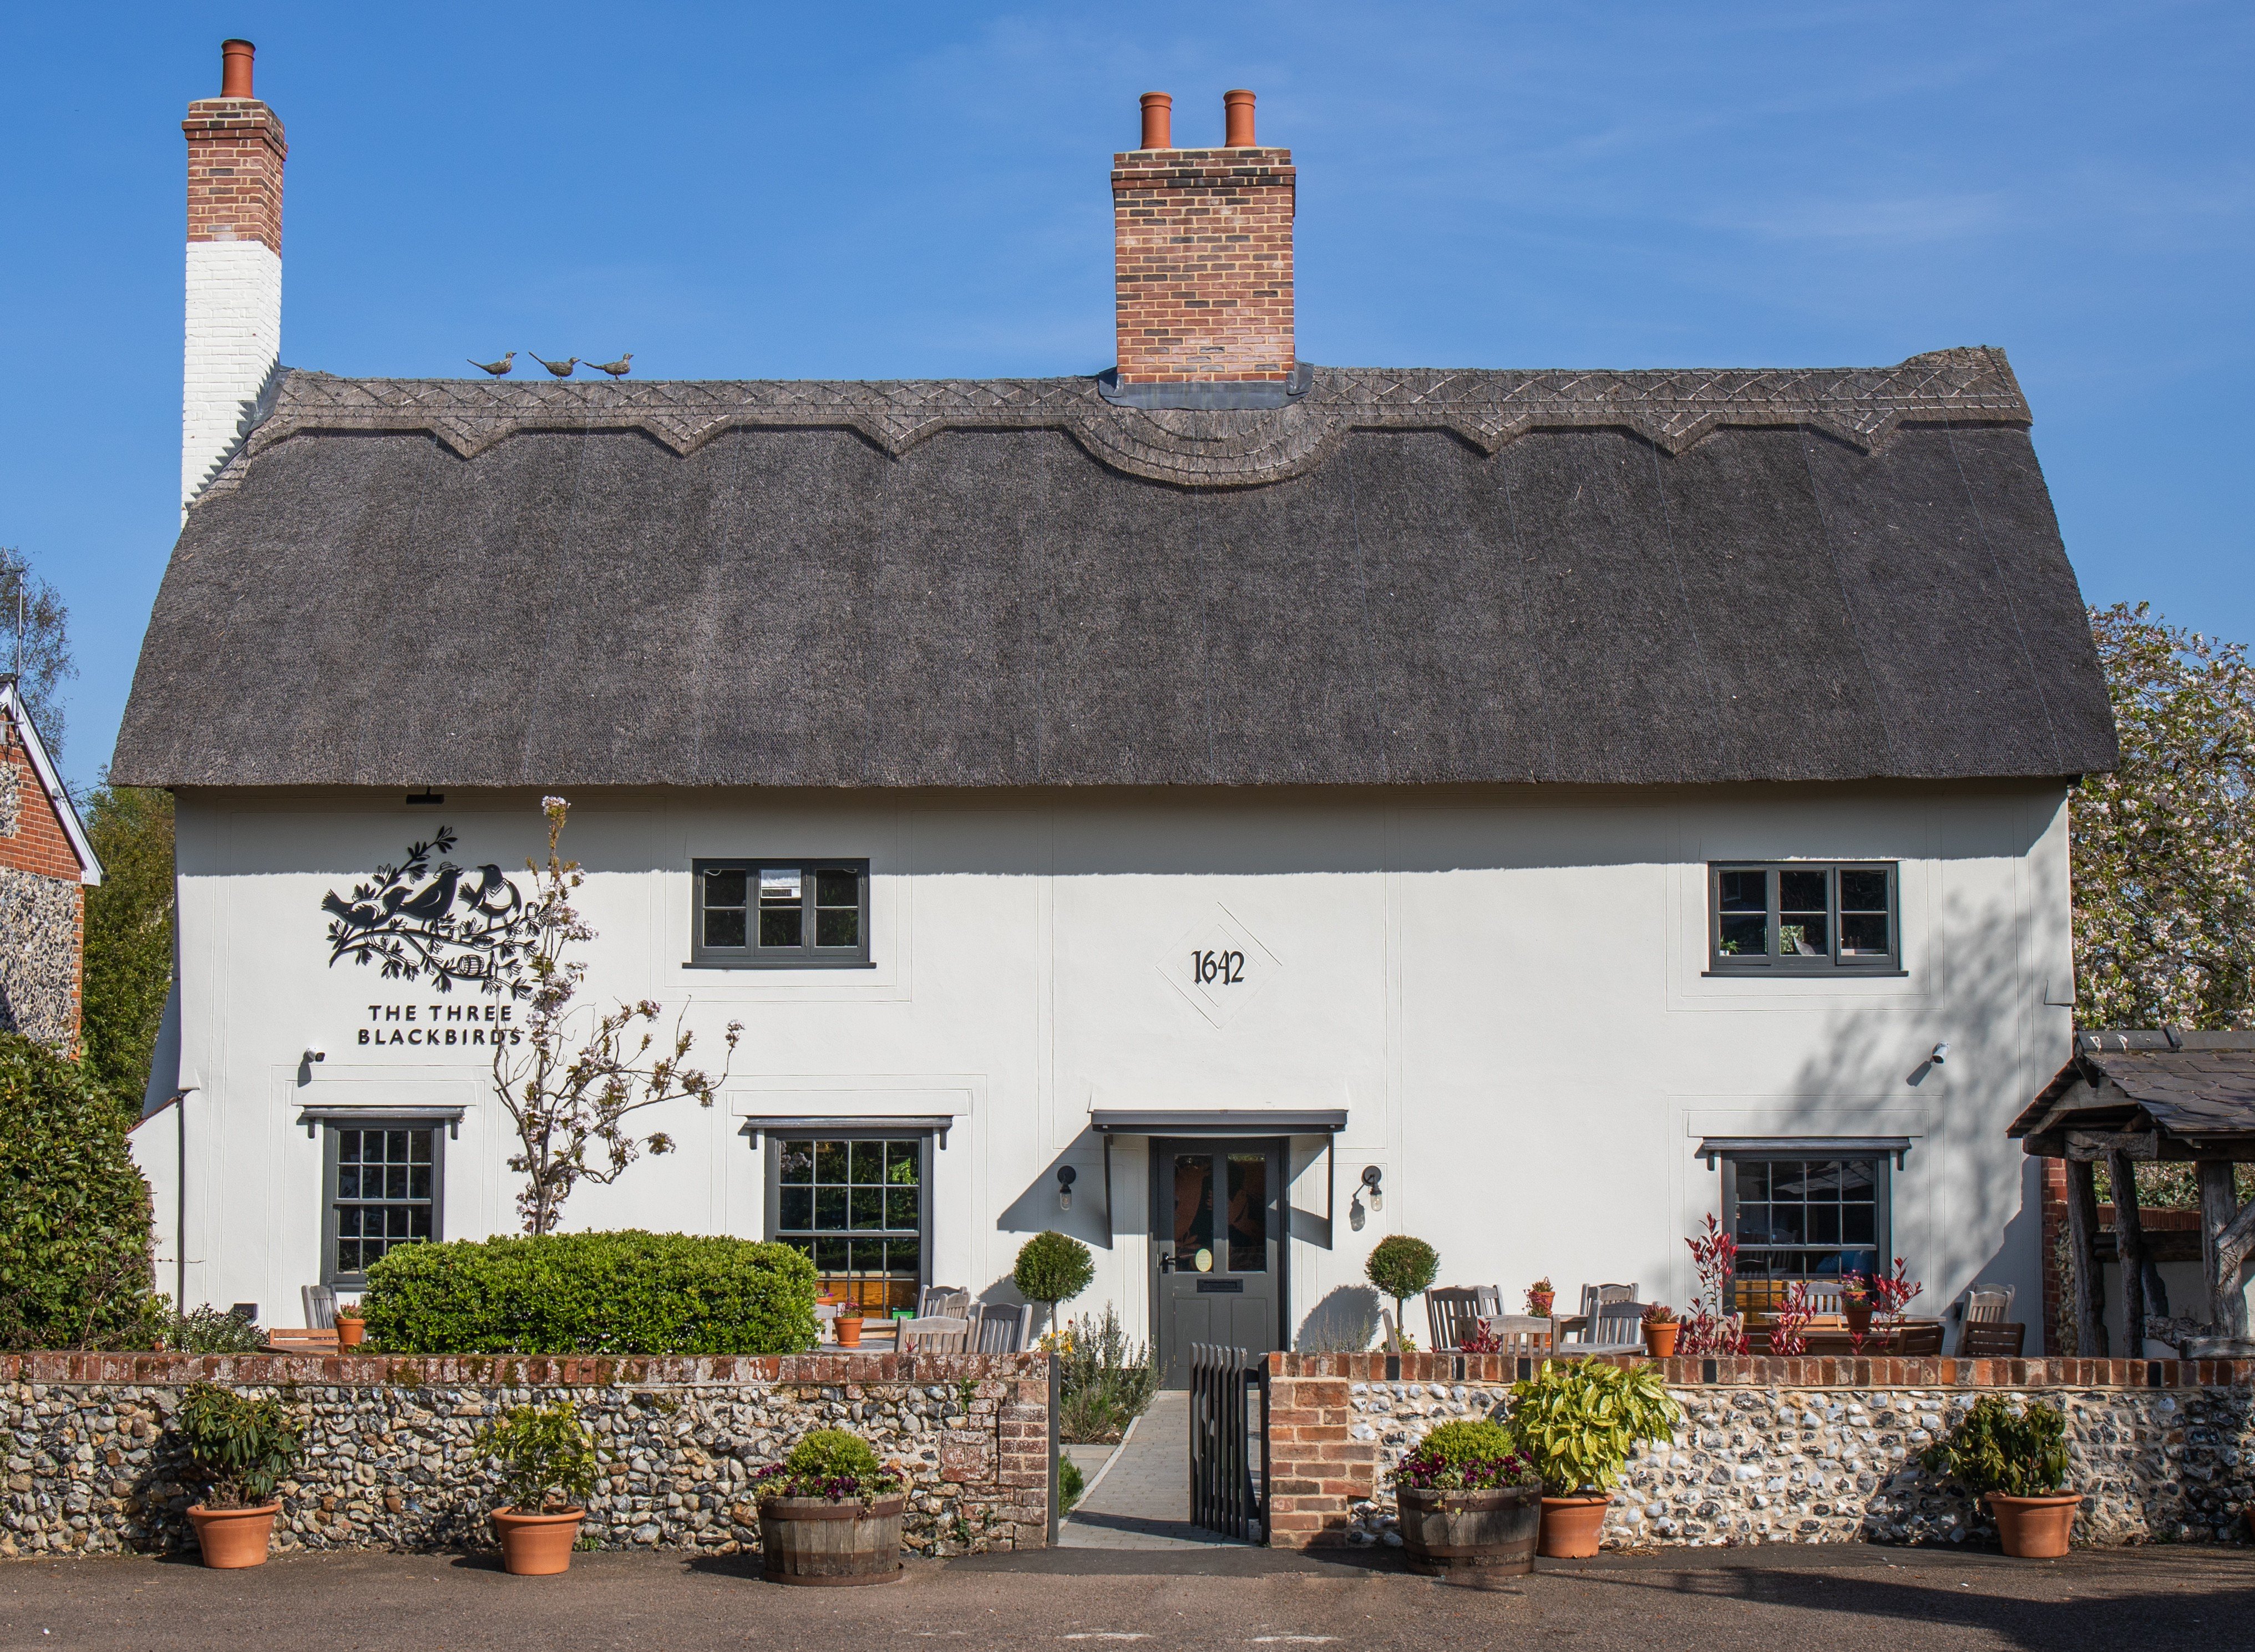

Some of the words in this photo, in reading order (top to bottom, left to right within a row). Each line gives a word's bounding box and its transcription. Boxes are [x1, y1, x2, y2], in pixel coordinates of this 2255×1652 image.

[1191, 950, 1244, 986] 1642
[368, 1005, 416, 1021] THE
[428, 1005, 511, 1021] THREE
[358, 1029, 521, 1045] BLACKBIRDS
